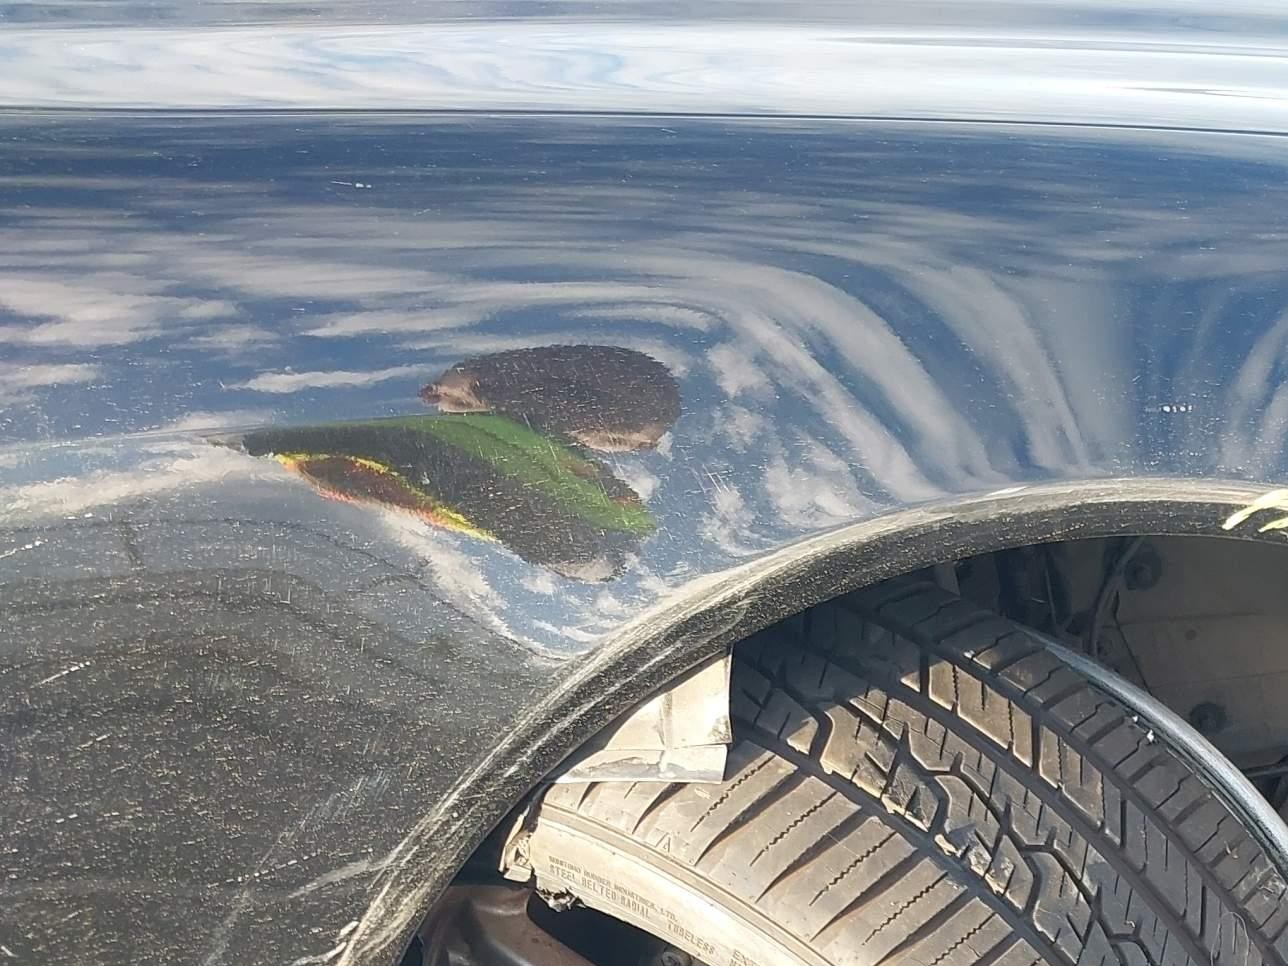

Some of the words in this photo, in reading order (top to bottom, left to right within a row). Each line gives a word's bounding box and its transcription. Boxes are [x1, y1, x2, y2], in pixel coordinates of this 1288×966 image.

[549, 863, 576, 881] STEEL
[581, 878, 617, 901] BELTED
[620, 895, 651, 919] RADIAL
[667, 919, 716, 955] TUBELESS
